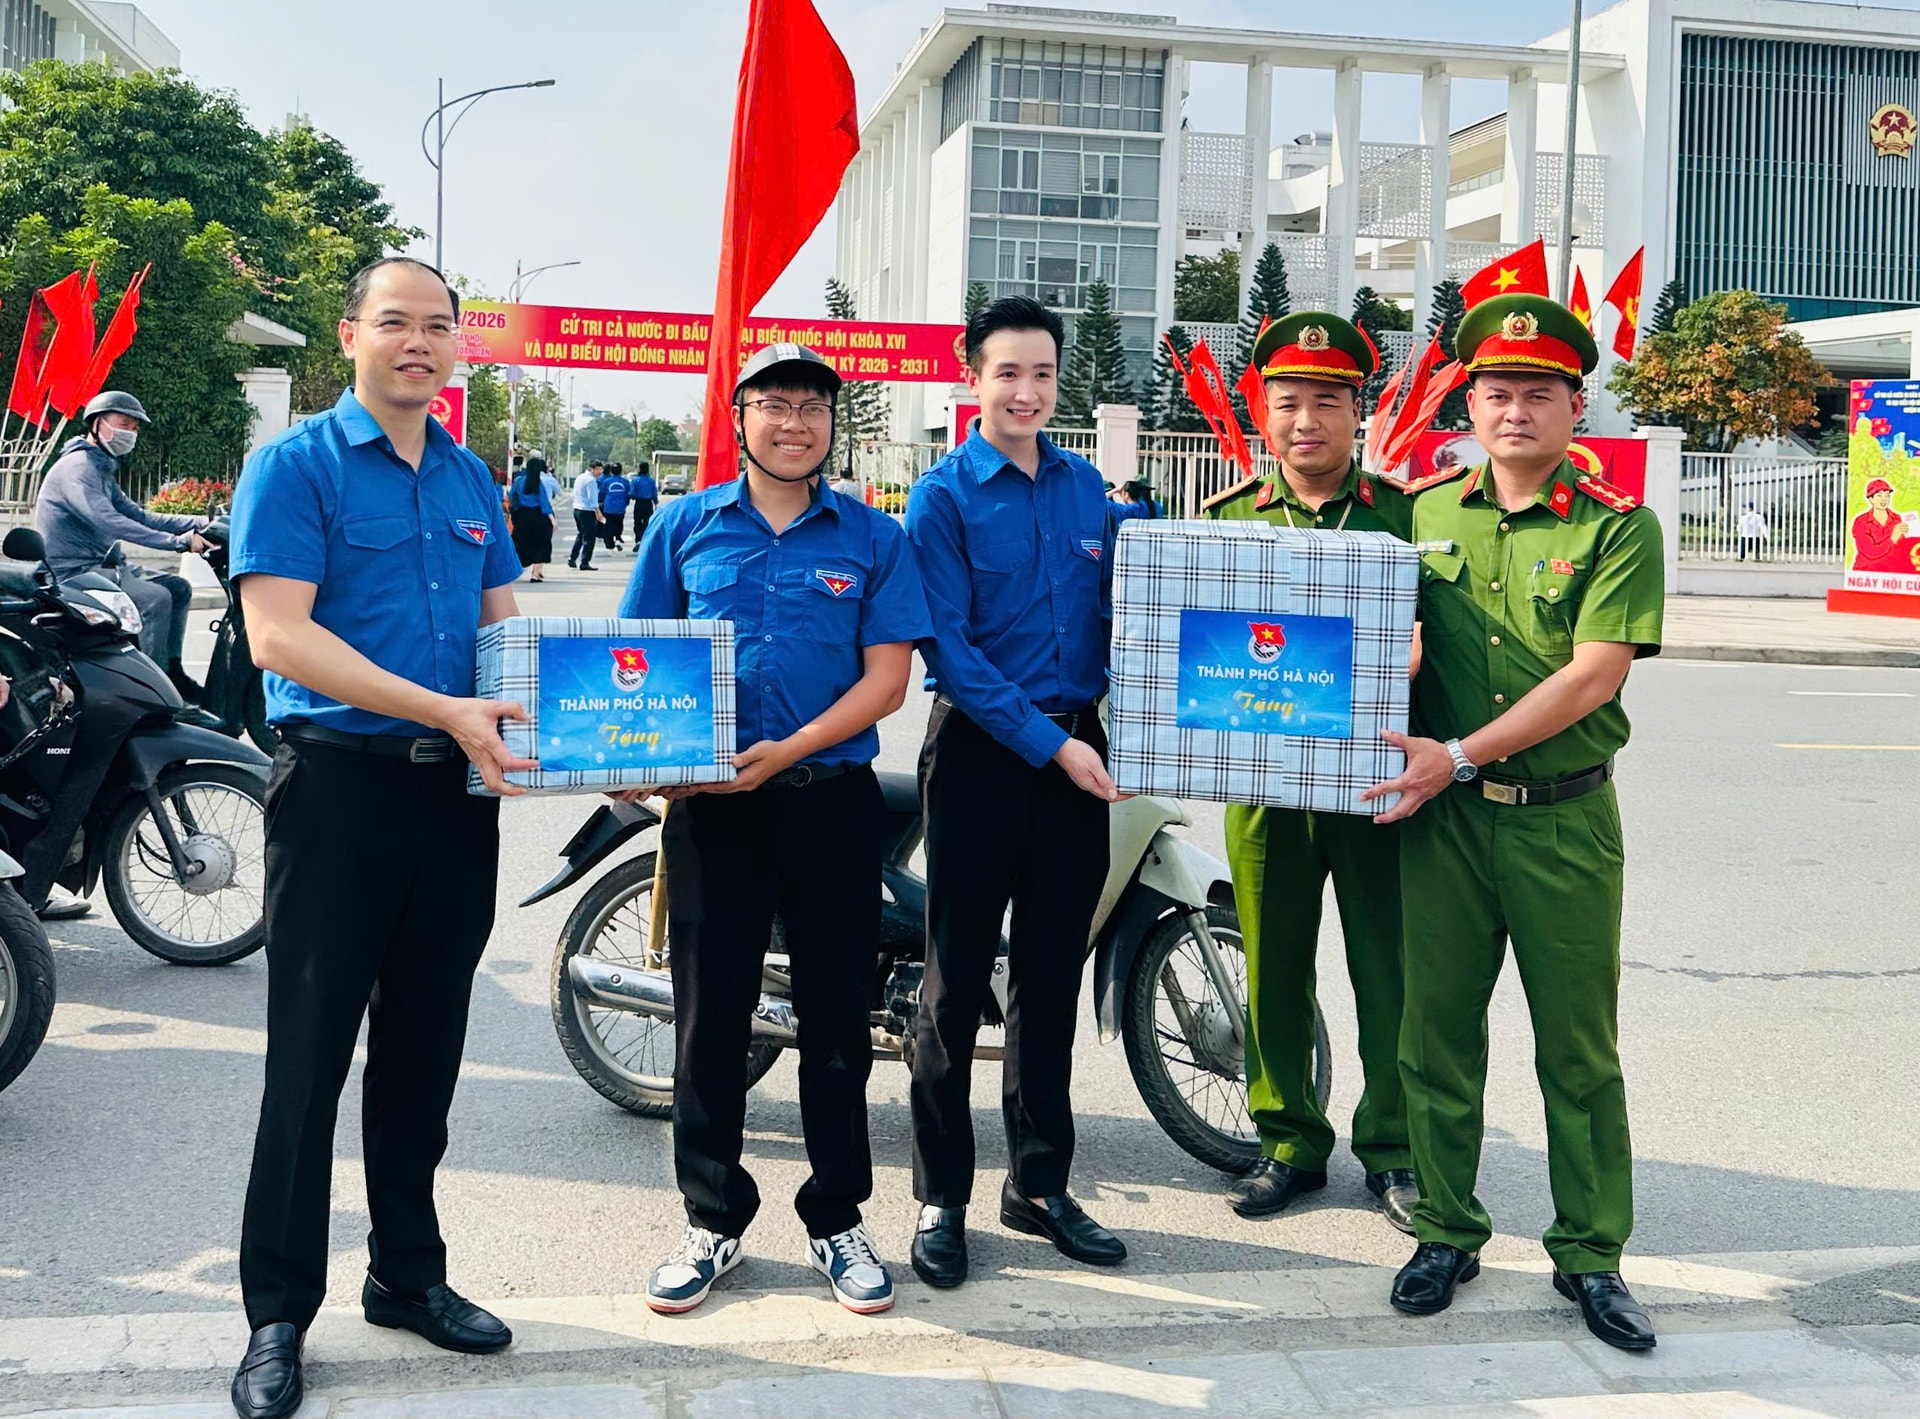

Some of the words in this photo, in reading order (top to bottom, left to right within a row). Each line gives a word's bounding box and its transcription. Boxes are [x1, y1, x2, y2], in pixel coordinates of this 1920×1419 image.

[560, 312, 580, 335] CỬ
[582, 319, 602, 337] TRI
[605, 315, 623, 338] CẢ
[627, 319, 663, 340] NƯỚC
[665, 321, 679, 339] ĐI
[682, 320, 709, 342] BẦU
[741, 327, 753, 346] ẠI
[757, 323, 785, 344] BIỂU
[788, 326, 822, 347] QUỐC
[825, 328, 846, 351] HỘI
[849, 329, 882, 349] KHÓA
[885, 334, 906, 350] XVI
[524, 338, 541, 358] VÀ
[545, 343, 567, 362] ĐẠI
[571, 339, 600, 361] BIỂU
[604, 346, 627, 366] HỘI
[630, 343, 665, 365] ĐỒNG
[668, 346, 705, 366] NHÂN
[839, 356, 856, 375] KỲ
[858, 357, 889, 374] 2026
[900, 359, 929, 375] 2031
[933, 360, 938, 375] !
[1848, 576, 1878, 588] NGÀY
[1882, 577, 1902, 591] HỘI
[1197, 664, 1244, 679] THÀNH
[1249, 665, 1279, 681] PHỐ
[1283, 669, 1304, 682] HÀ
[1308, 669, 1335, 686] NỘI
[559, 696, 609, 711] THÀNH
[614, 693, 644, 711] PHỐ
[647, 694, 668, 709] HÀ
[672, 694, 697, 712] NỘI
